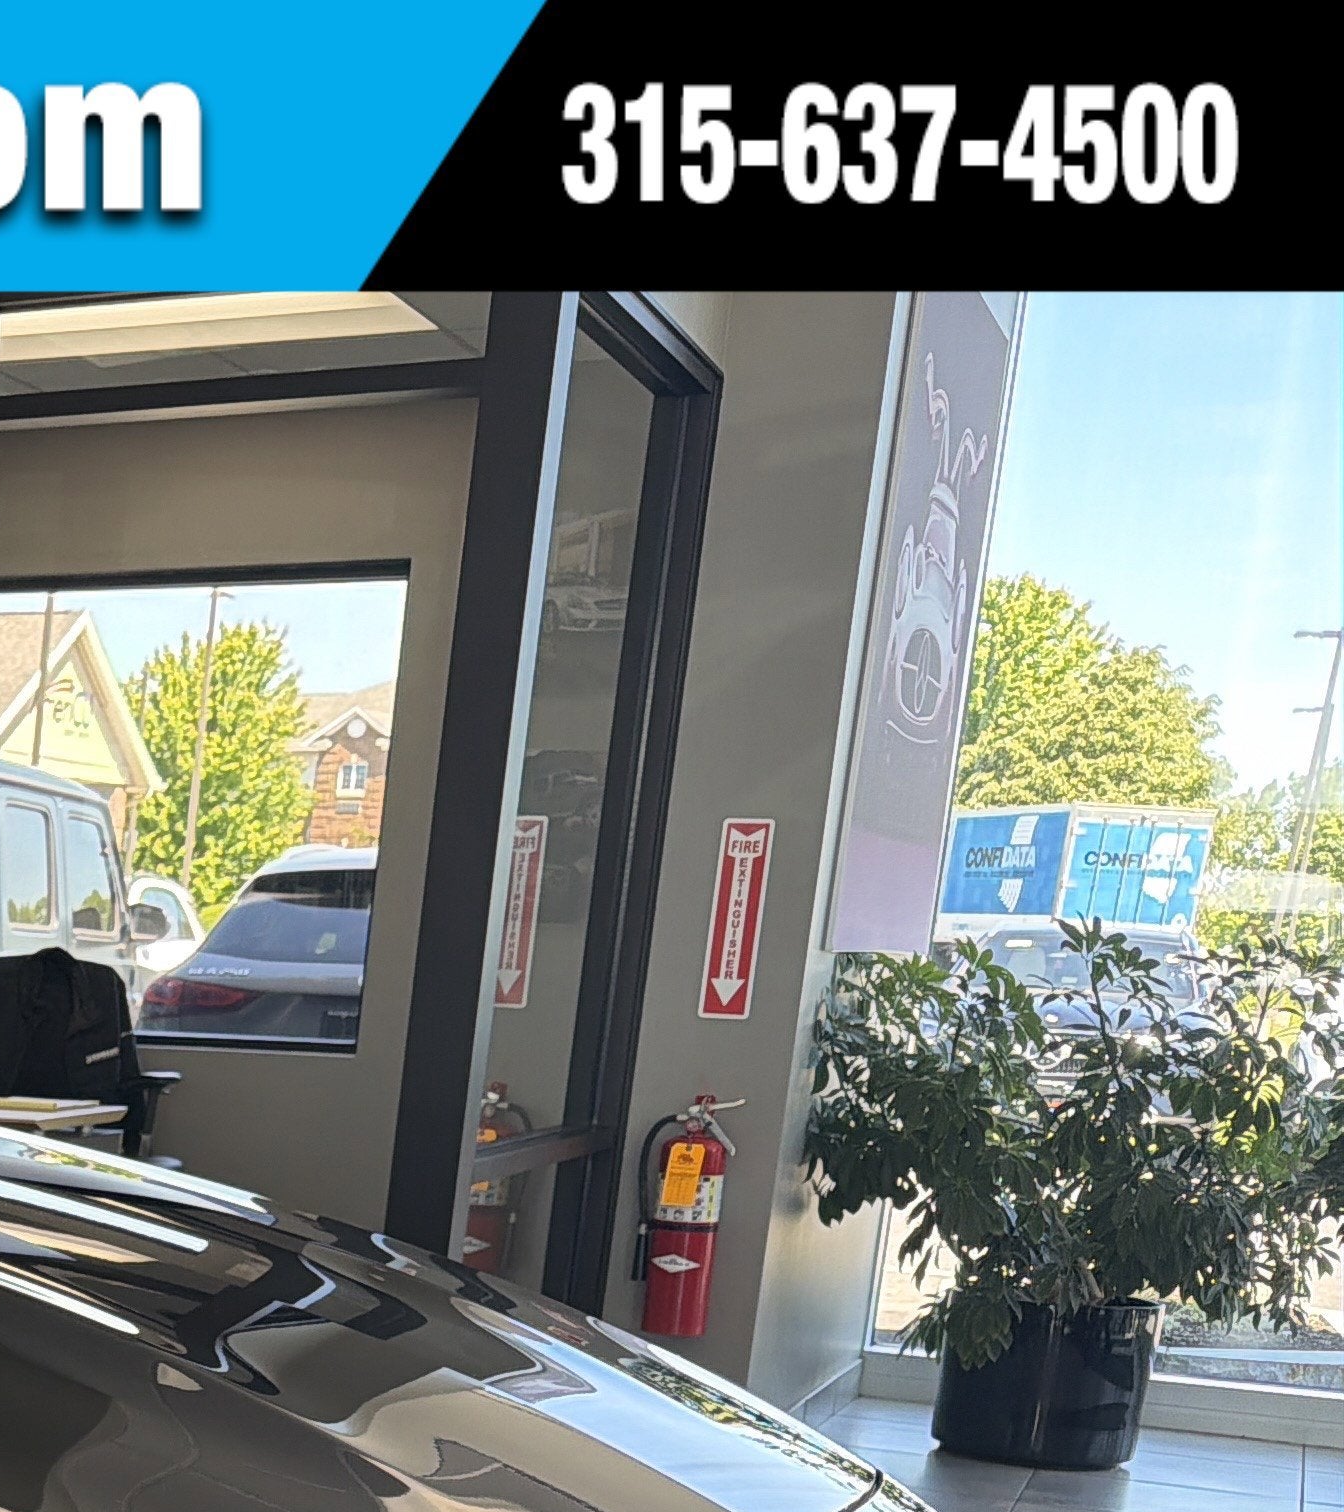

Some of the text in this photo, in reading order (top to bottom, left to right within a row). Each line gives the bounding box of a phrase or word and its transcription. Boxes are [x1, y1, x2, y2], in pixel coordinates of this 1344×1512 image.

[731, 839, 761, 854] FIRE
[965, 846, 1036, 868] CONFIDATA
[724, 857, 749, 980] EXTINGUISHER
